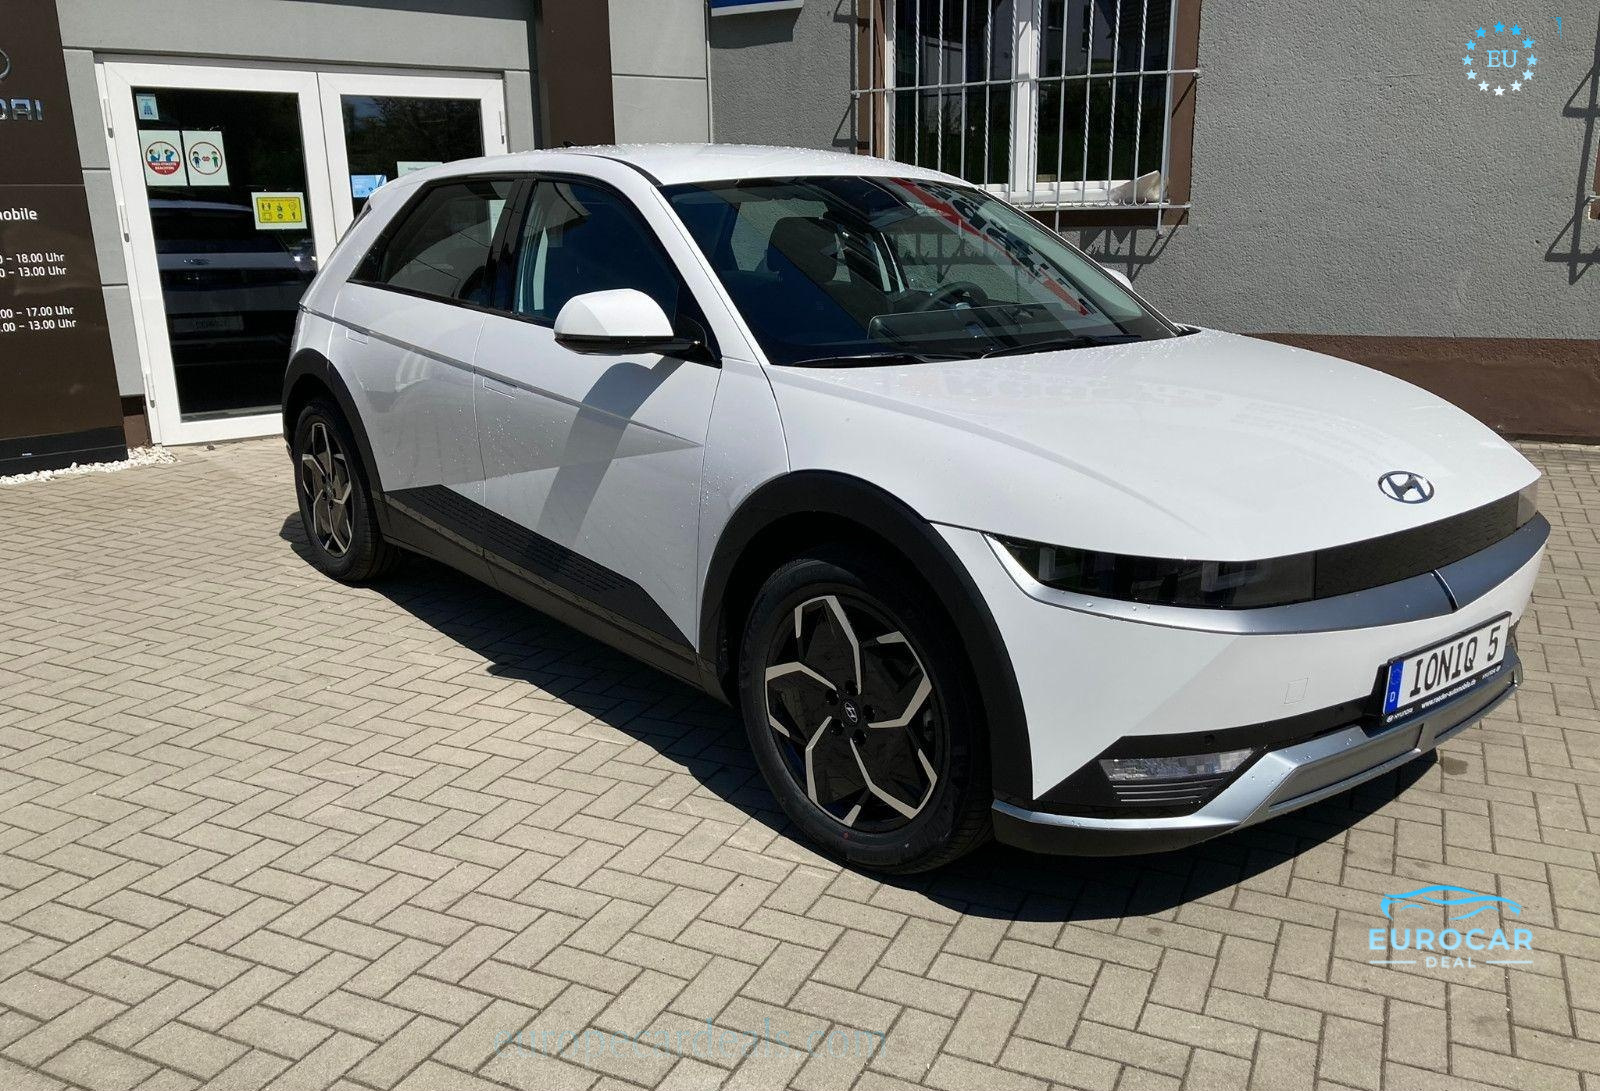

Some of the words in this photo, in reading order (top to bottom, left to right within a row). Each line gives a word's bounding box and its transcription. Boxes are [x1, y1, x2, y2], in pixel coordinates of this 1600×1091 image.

[0, 207, 38, 221] obile
[16, 252, 43, 264] 18.00
[46, 252, 65, 263] Uhr
[18, 265, 45, 277] 13.00
[48, 265, 67, 276] Uhr
[0, 308, 13, 319] 00
[26, 306, 53, 318] 17.00
[55, 305, 74, 316] Uhr
[28, 319, 55, 331] 13.00
[58, 318, 77, 329] Uhr
[1409, 636, 1478, 698] IONIQ
[1487, 624, 1502, 662] 5
[1389, 691, 1396, 703] D
